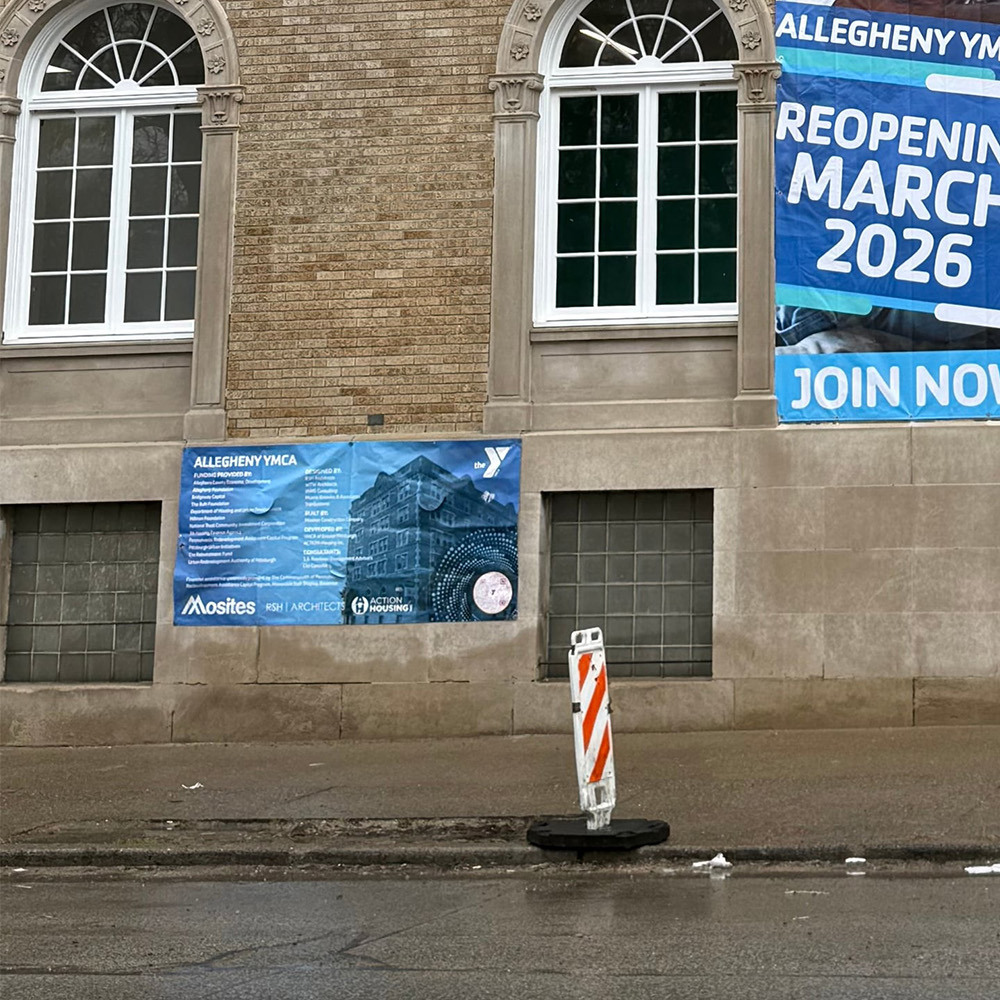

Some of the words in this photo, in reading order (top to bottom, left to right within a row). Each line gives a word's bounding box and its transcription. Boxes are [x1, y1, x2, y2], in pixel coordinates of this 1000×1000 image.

[775, 12, 955, 56] ALLEGHENY
[816, 218, 974, 288] 2026
[791, 365, 900, 410] JOIN
[193, 455, 262, 468] ALLEGHENY
[263, 454, 297, 466] YMCA
[181, 594, 257, 616] Mosites
[266, 601, 283, 612] RSH
[291, 601, 345, 612] ARCHITECTS
[370, 597, 402, 605] ACTION
